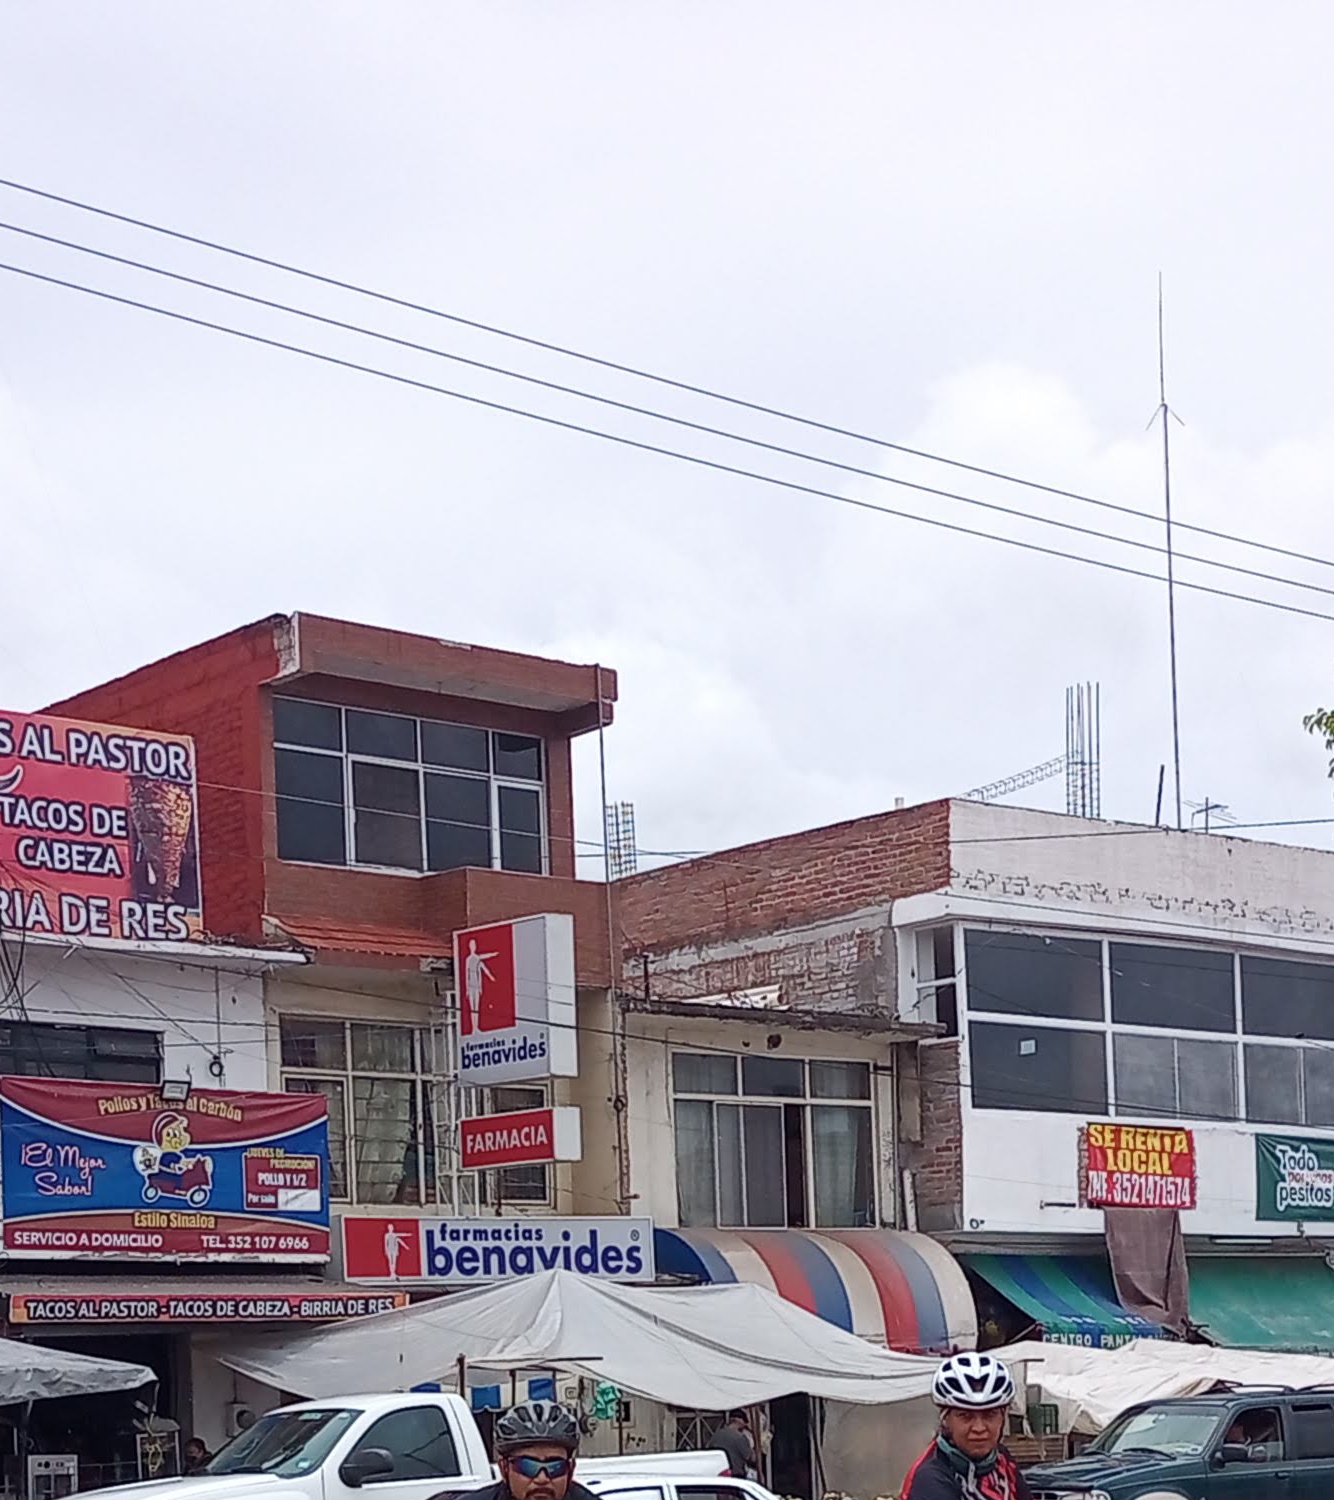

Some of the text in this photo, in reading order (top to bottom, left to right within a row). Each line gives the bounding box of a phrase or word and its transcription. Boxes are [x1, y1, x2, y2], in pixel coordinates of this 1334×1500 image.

[20, 727, 63, 762] AL
[69, 733, 189, 778] PASTOR
[92, 806, 127, 837] DE
[18, 838, 123, 875] CABEZA
[61, 895, 110, 936] DE
[120, 900, 188, 940] RES
[461, 1036, 547, 1070] benavides
[98, 1096, 138, 1115] Pollos
[138, 1097, 147, 1111] y
[199, 1098, 243, 1122] Carbón
[467, 1125, 548, 1154] FARMACIA
[1088, 1124, 1189, 1154] SE RENTA
[57, 1145, 107, 1178] Mejor
[1106, 1148, 1173, 1175] LOCAL
[1277, 1147, 1316, 1171] Todo
[35, 1172, 93, 1196] Sabor!
[257, 1172, 285, 1185] POLLO
[1278, 1183, 1332, 1209] pesitos
[134, 1211, 216, 1228] Estilo Sinaloa
[14, 1231, 163, 1248] SERVICIO A DOMICILIO
[227, 1234, 252, 1249] 352
[254, 1235, 276, 1249] 107
[278, 1236, 310, 1250] 6966
[425, 1222, 643, 1277] farmacias benavides
[27, 1301, 77, 1318] TACOS
[78, 1301, 98, 1318] AL
[101, 1301, 157, 1318] PASTOR
[169, 1301, 213, 1317] TACOS
[216, 1300, 235, 1316] DE
[238, 1299, 291, 1316] CABEZA
[300, 1299, 345, 1317] BIRRIA
[347, 1299, 366, 1315] DE
[368, 1298, 393, 1314] RES
